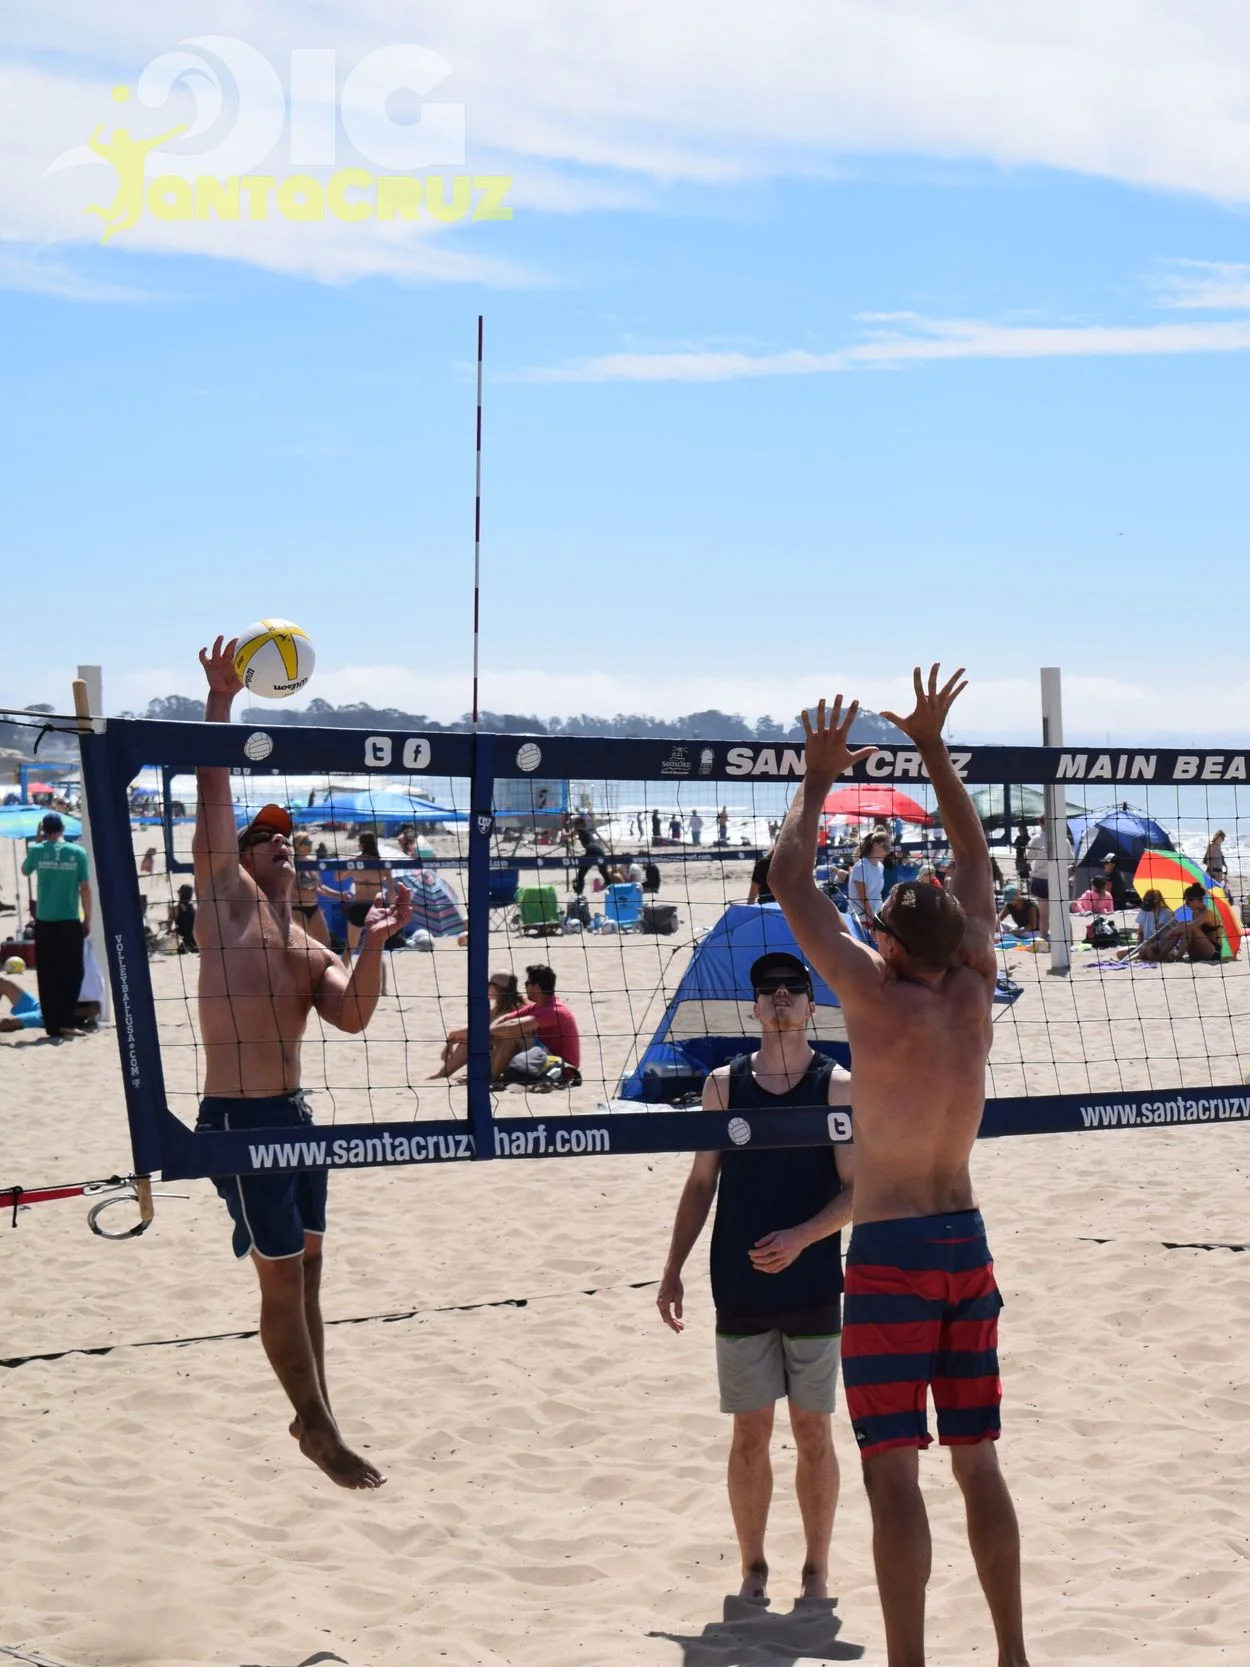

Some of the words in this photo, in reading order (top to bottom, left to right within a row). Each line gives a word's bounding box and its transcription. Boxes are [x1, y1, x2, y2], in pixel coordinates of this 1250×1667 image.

[272, 677, 308, 691] Wilson
[725, 747, 854, 777] SAN
[865, 750, 973, 778] CRZ
[1056, 754, 1157, 780] MAIN
